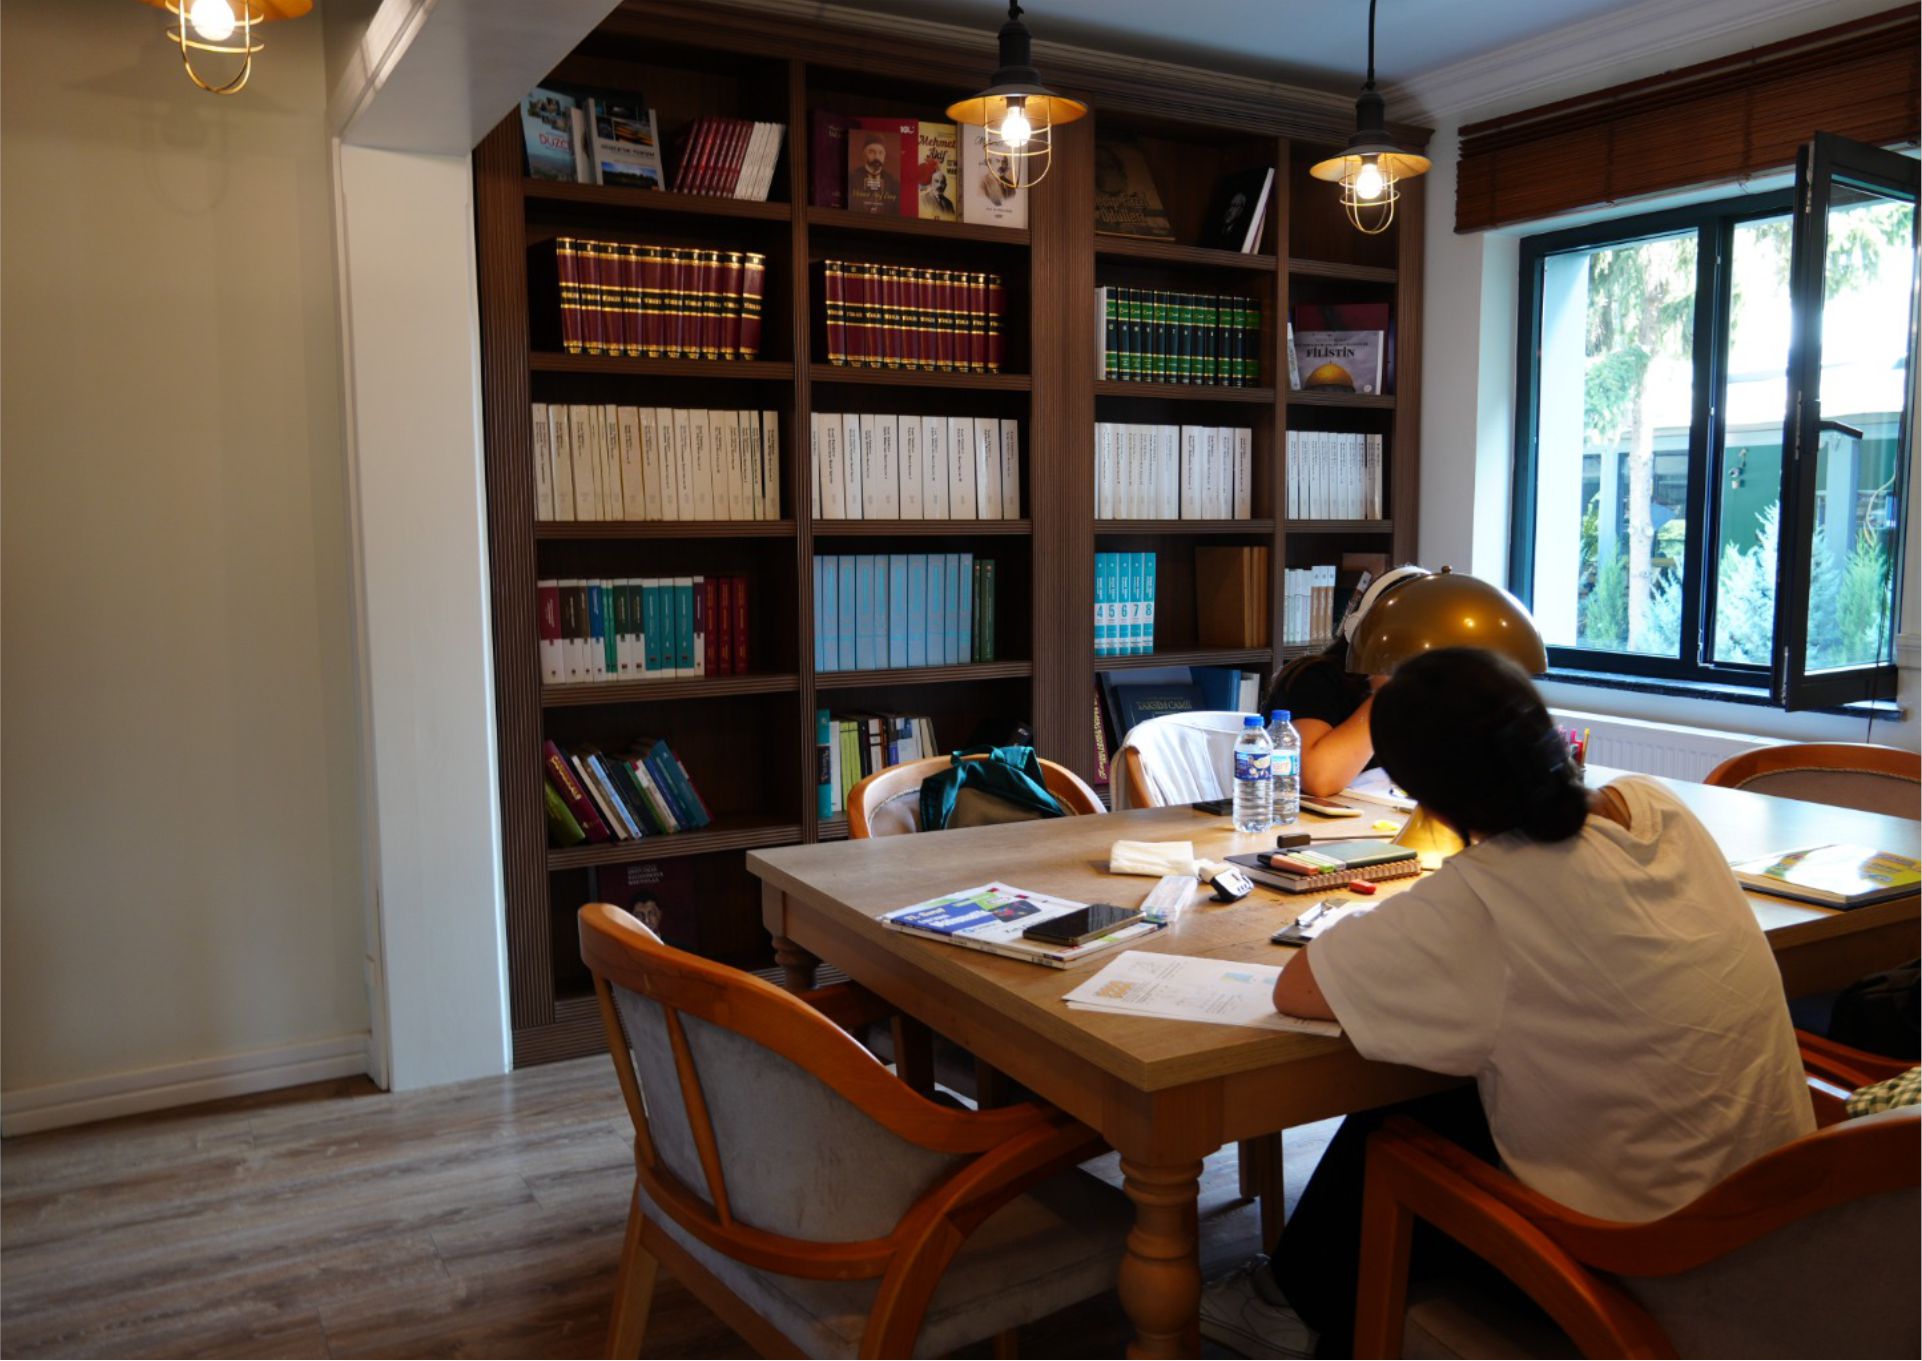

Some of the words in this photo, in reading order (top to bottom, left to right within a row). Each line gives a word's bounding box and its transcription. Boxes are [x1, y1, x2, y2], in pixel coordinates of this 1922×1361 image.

[1306, 346, 1355, 358] FİLİSTİN
[1097, 604, 1104, 618] 4
[1108, 604, 1115, 618] 5
[1121, 604, 1128, 617] 6
[1133, 603, 1139, 617] 7
[1146, 603, 1152, 616] 8
